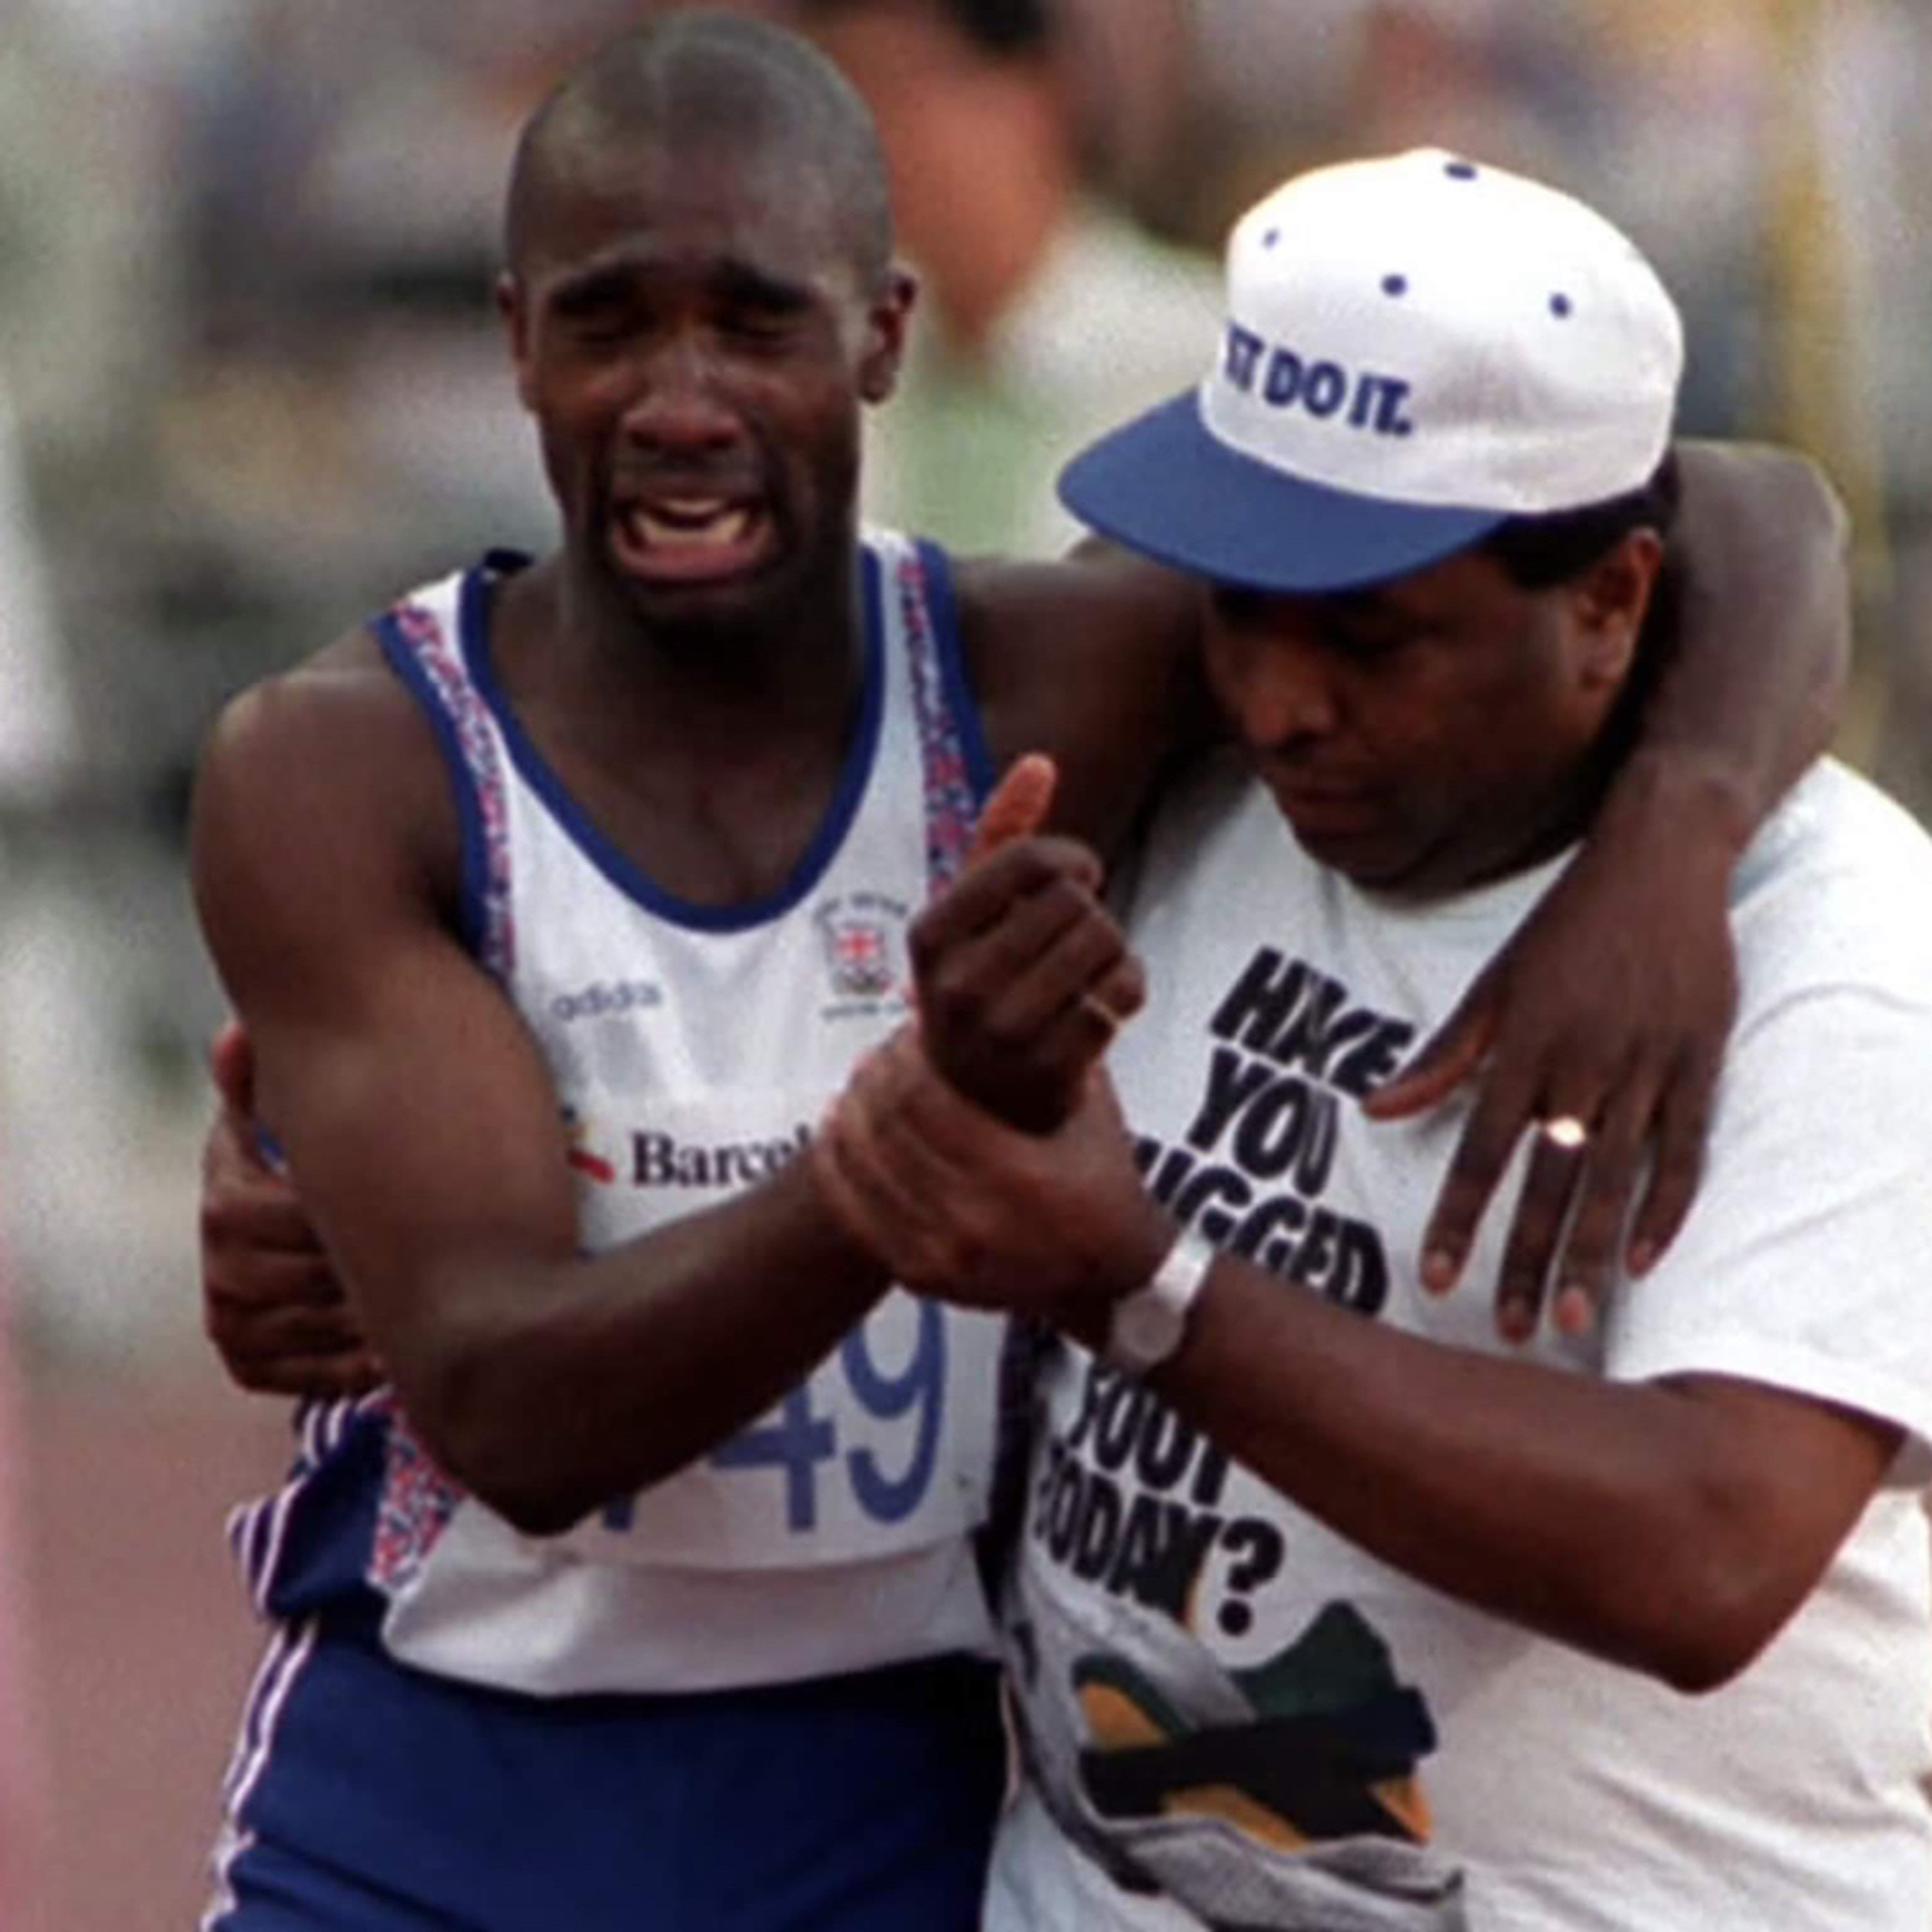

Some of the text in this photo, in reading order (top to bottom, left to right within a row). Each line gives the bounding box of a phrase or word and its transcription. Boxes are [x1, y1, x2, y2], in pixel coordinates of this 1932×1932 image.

[1264, 346, 1346, 417] DO
[1348, 372, 1412, 436] IT.
[1186, 1046, 1340, 1197] YOU
[603, 1296, 947, 1532] 49
